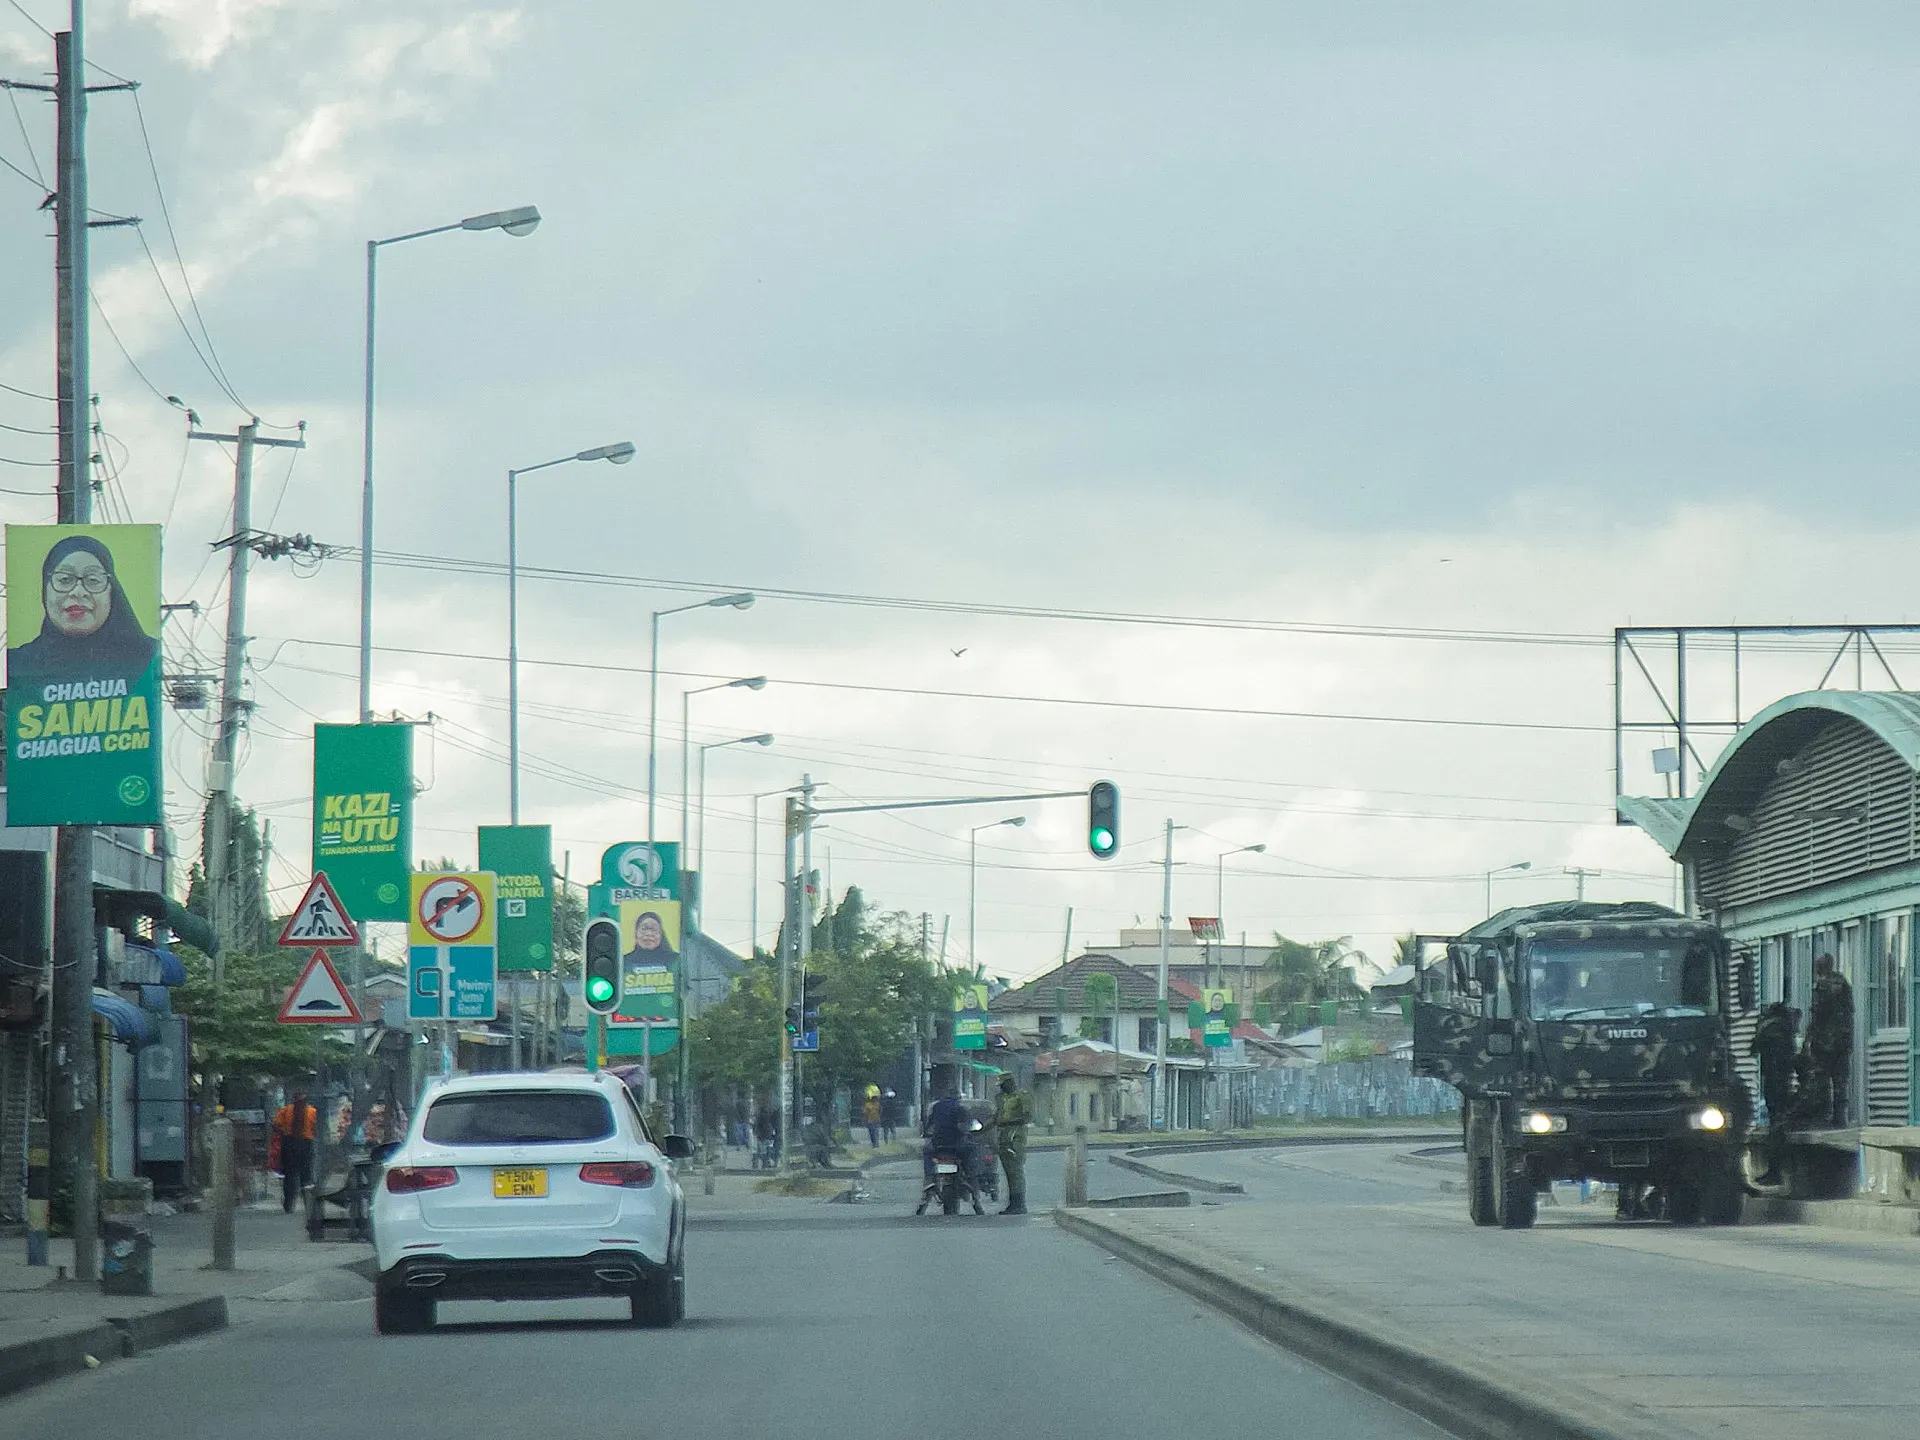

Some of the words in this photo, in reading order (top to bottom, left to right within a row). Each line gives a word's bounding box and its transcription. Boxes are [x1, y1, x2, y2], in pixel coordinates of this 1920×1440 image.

[43, 678, 128, 702] CHAGUA
[17, 696, 150, 740] SAMIA
[17, 735, 102, 760] CHAGUA
[103, 731, 151, 752] CCM
[324, 792, 391, 819] KAZI
[321, 821, 342, 834] NA
[343, 816, 400, 843] UTU
[496, 887, 545, 899] UNATIKI
[624, 972, 674, 987] SAMIA
[1608, 1029, 1648, 1039] IVECO
